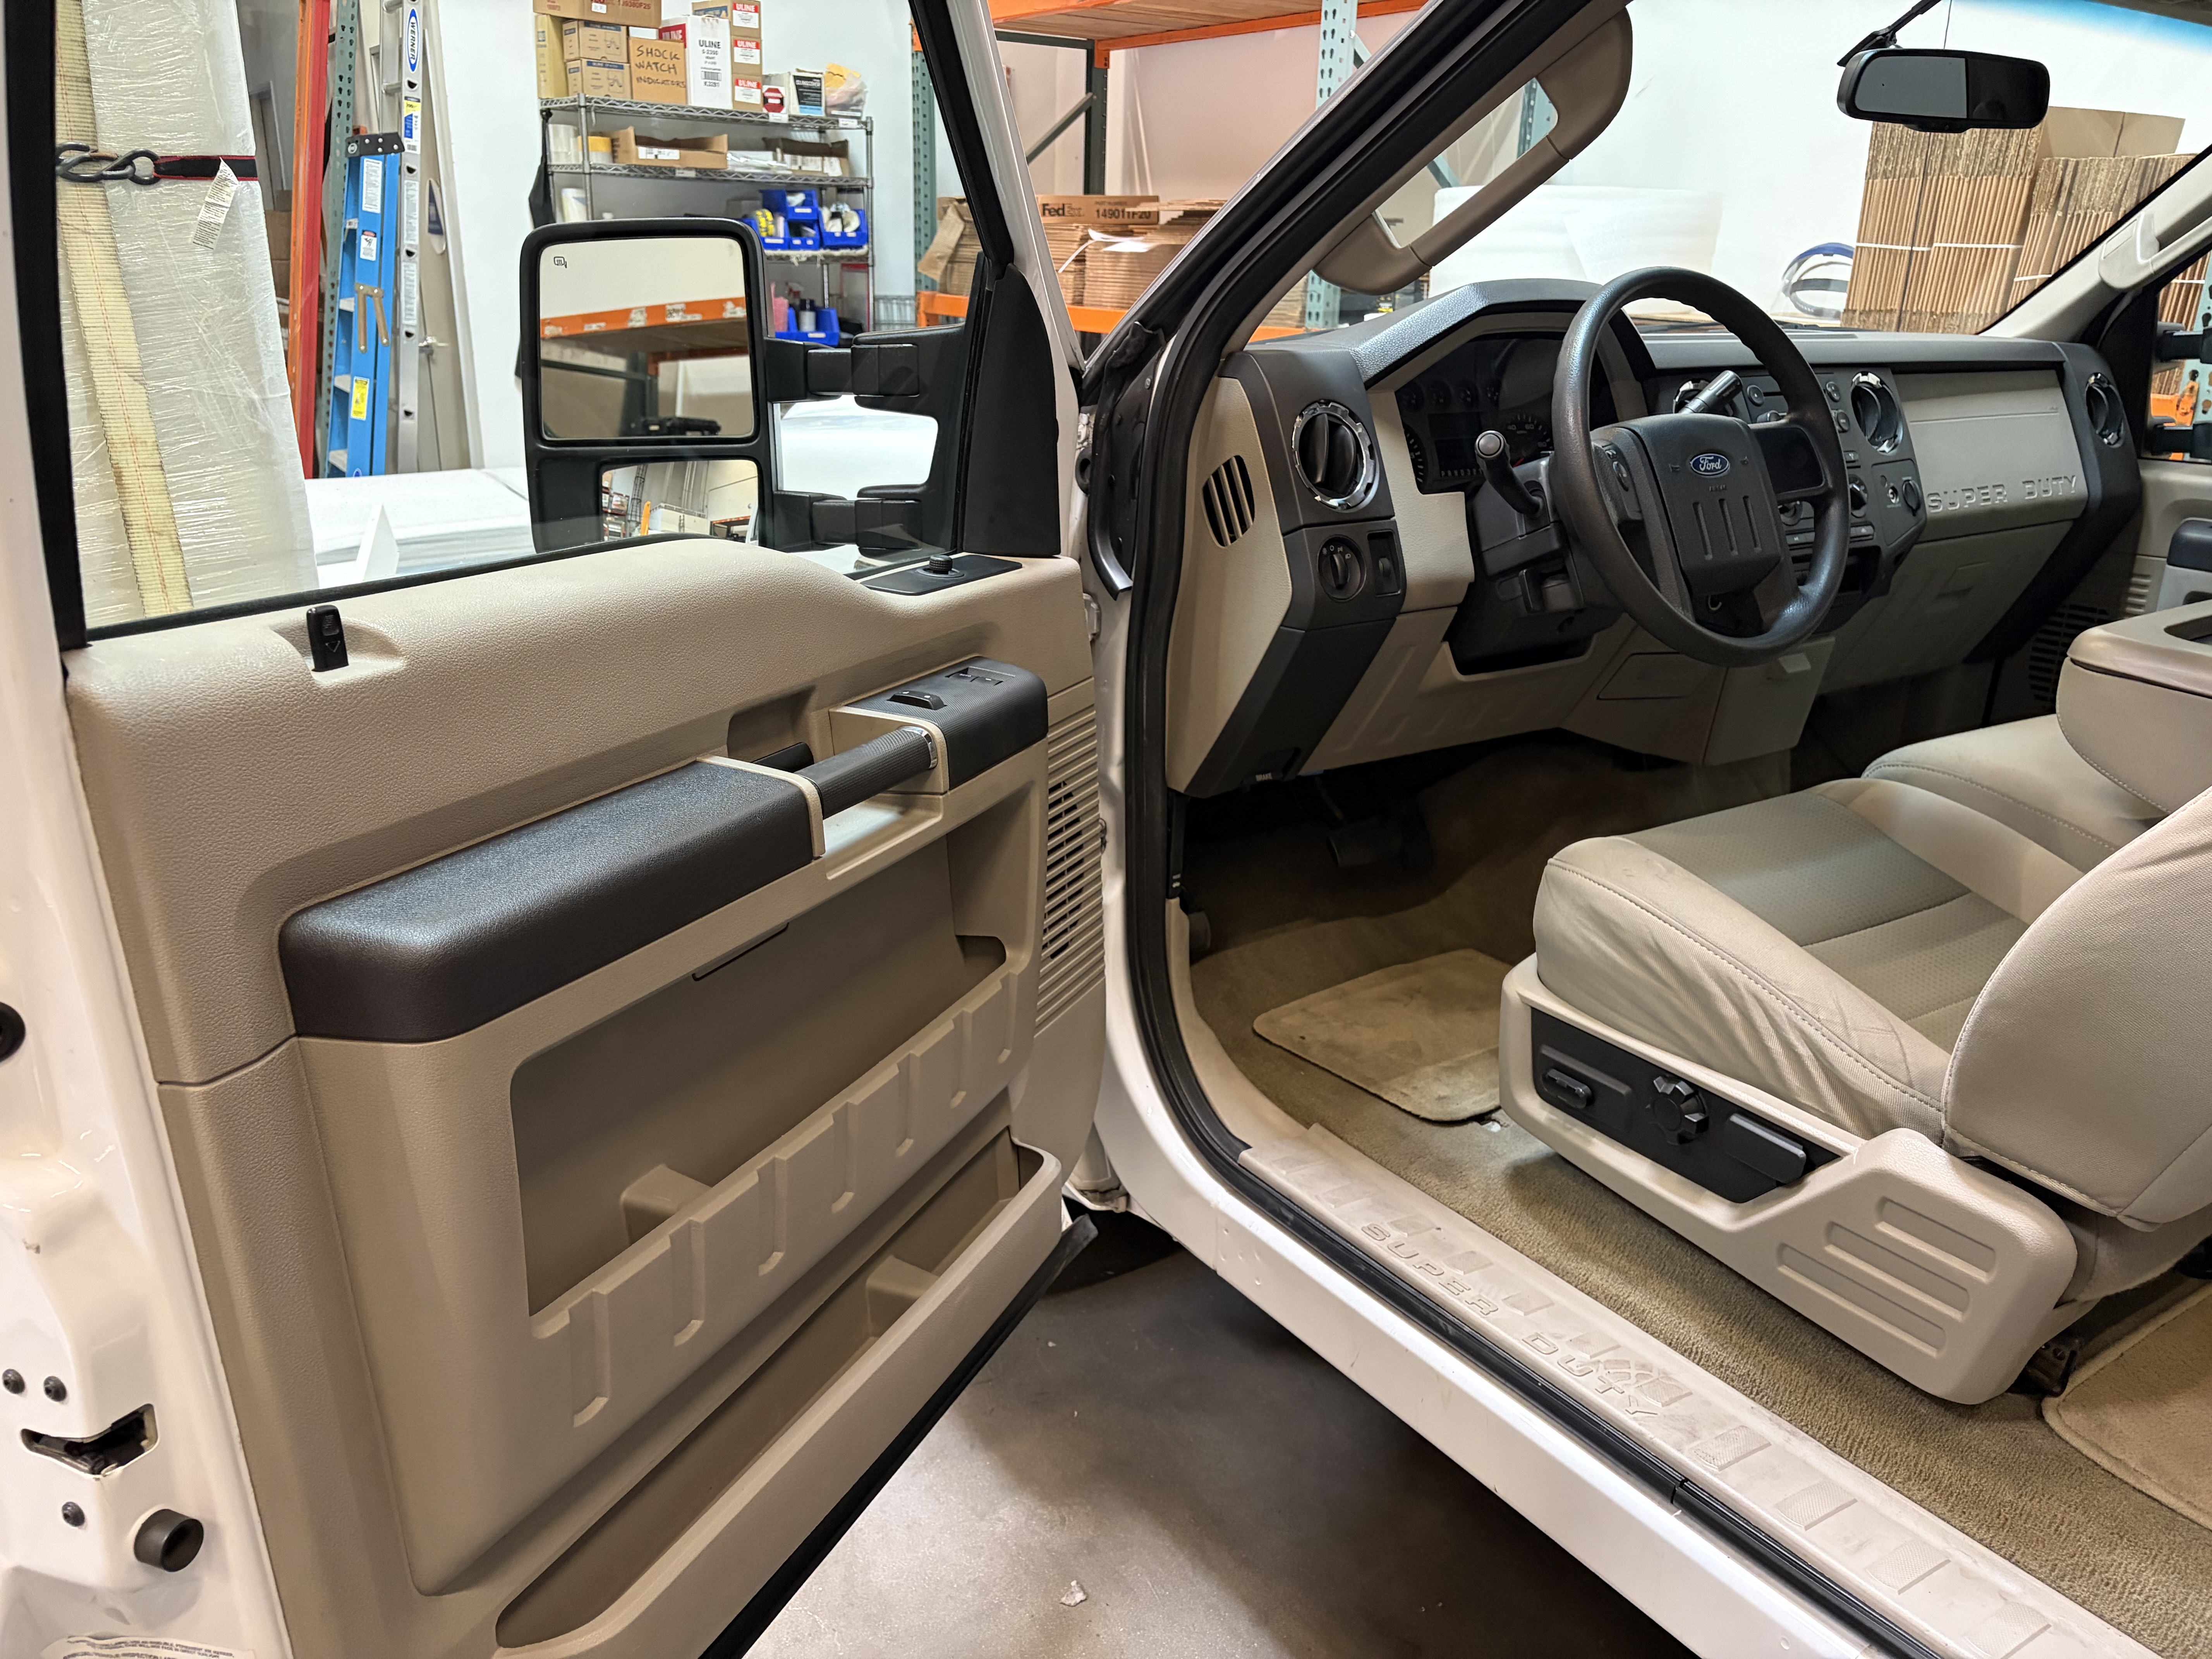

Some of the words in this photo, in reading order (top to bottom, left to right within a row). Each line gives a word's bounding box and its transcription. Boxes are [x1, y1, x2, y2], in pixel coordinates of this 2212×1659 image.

[736, 3, 756, 12] ULINE
[699, 39, 721, 49] ULINE
[737, 40, 756, 49] ULINE
[636, 45, 680, 60] SHOCK
[635, 62, 677, 75] WATCH
[636, 77, 687, 88] INDICATORS
[738, 80, 757, 88] ULINE
[1042, 203, 1084, 217] FedEx
[1699, 456, 1722, 471] Ford
[1927, 484, 2008, 513] SUPER
[2022, 475, 2076, 500] DUTY
[1361, 1223, 1499, 1316] SUPER
[1522, 1331, 1658, 1415] DUTY
